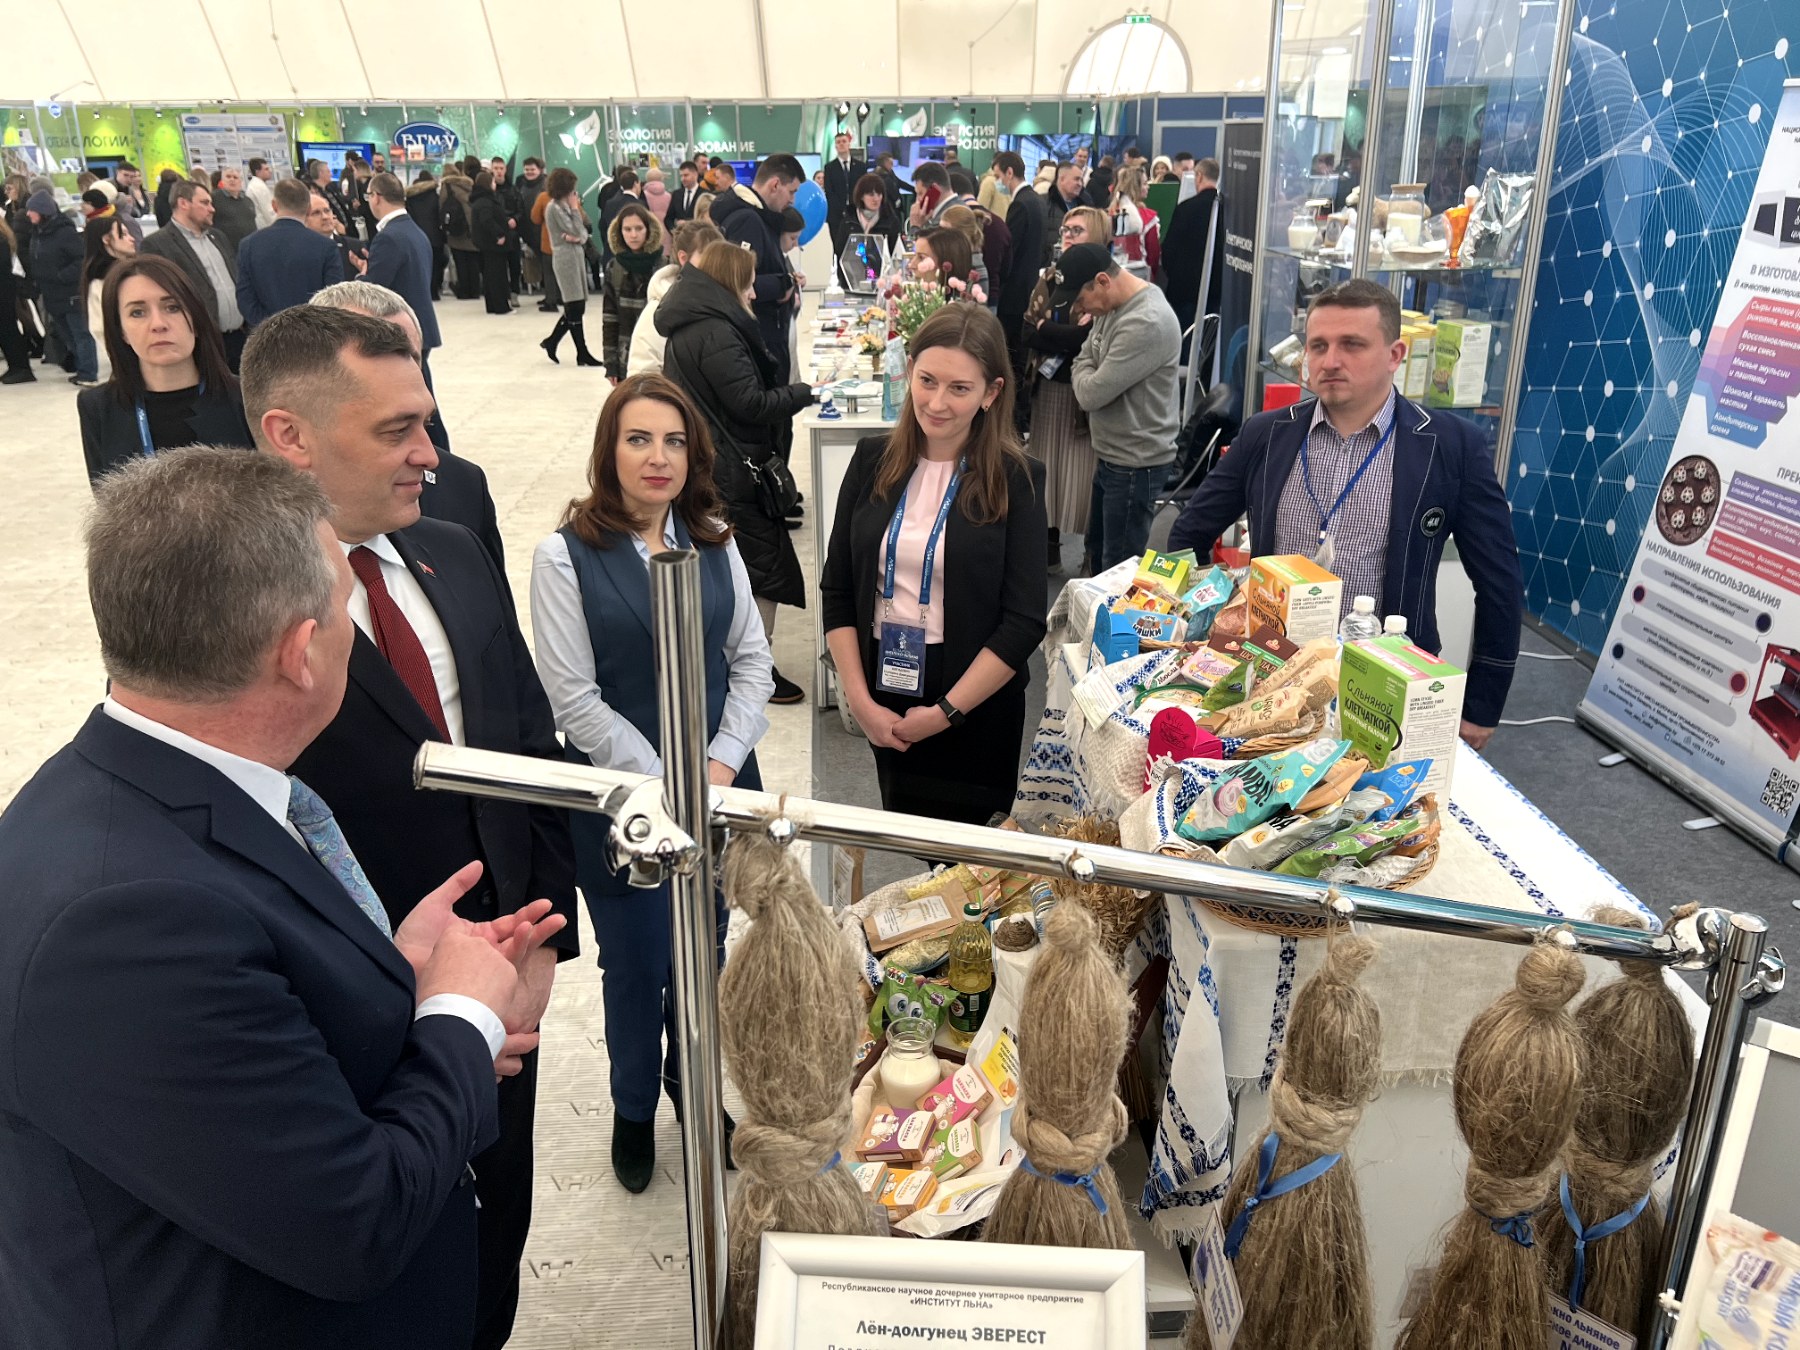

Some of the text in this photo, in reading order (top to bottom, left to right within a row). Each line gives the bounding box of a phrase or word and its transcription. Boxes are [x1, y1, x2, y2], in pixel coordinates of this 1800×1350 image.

[1645, 540, 1700, 573] НАПРАВЛЕНИЯ
[1701, 565, 1782, 610] ИСПОЛЬЗОВАНИЯ
[1344, 697, 1390, 735] КЛЕТЧАТКОЙ
[822, 1281, 1084, 1304] Республиканское научное дочернее унитарное предприятие
[910, 1297, 993, 1309] «ИНСТИТУТ ЛЬНА»
[856, 1320, 1046, 1345] Лён-долгунец ЭВЕРЕСТ
[1573, 1319, 1620, 1350] льняное
